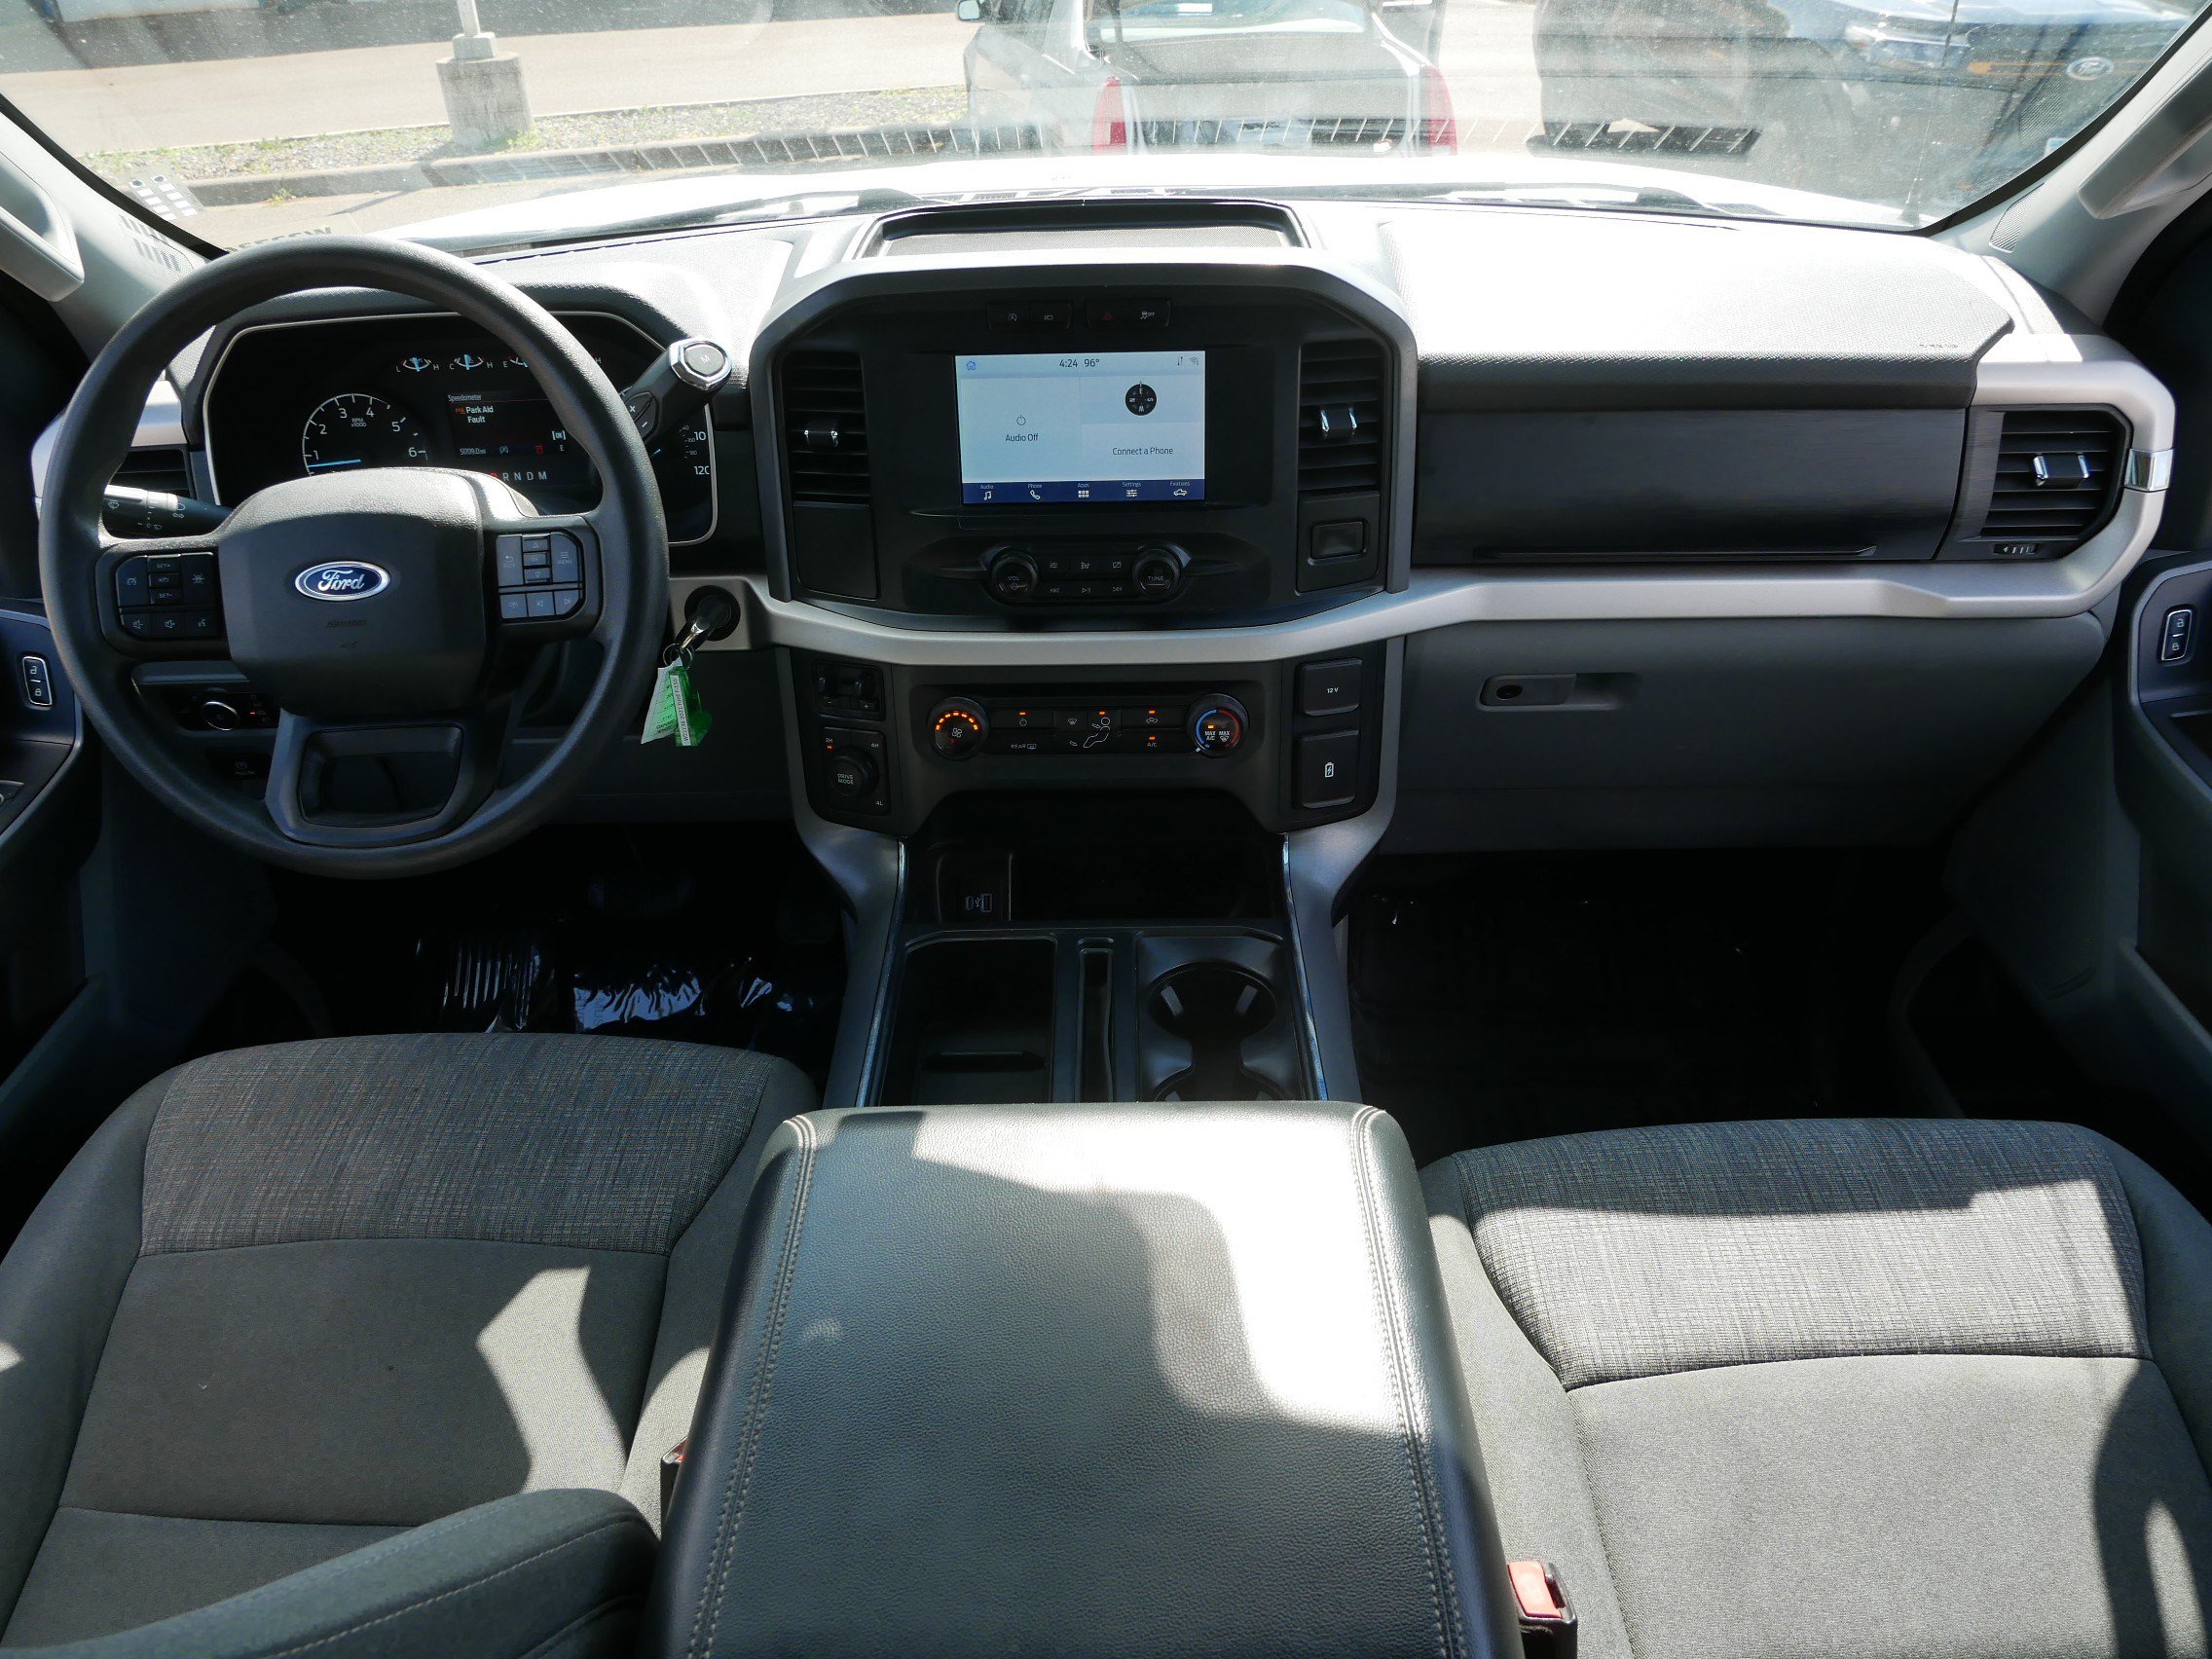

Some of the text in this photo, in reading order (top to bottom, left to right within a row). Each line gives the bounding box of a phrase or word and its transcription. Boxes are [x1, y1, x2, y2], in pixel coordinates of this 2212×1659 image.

[1059, 358, 1100, 368] 4:24 96°
[447, 394, 482, 402] Speedometer
[338, 407, 348, 419] 3
[366, 407, 375, 418] 4
[465, 406, 482, 414] Park
[318, 424, 328, 435] 2
[391, 422, 401, 432] 5
[1005, 433, 1039, 442] Audio Off
[313, 450, 319, 460] 1
[408, 447, 417, 457] 6
[503, 472, 510, 481] R
[514, 472, 522, 481] N
[527, 472, 534, 481] D
[538, 471, 547, 480] M
[317, 570, 365, 591] Ford
